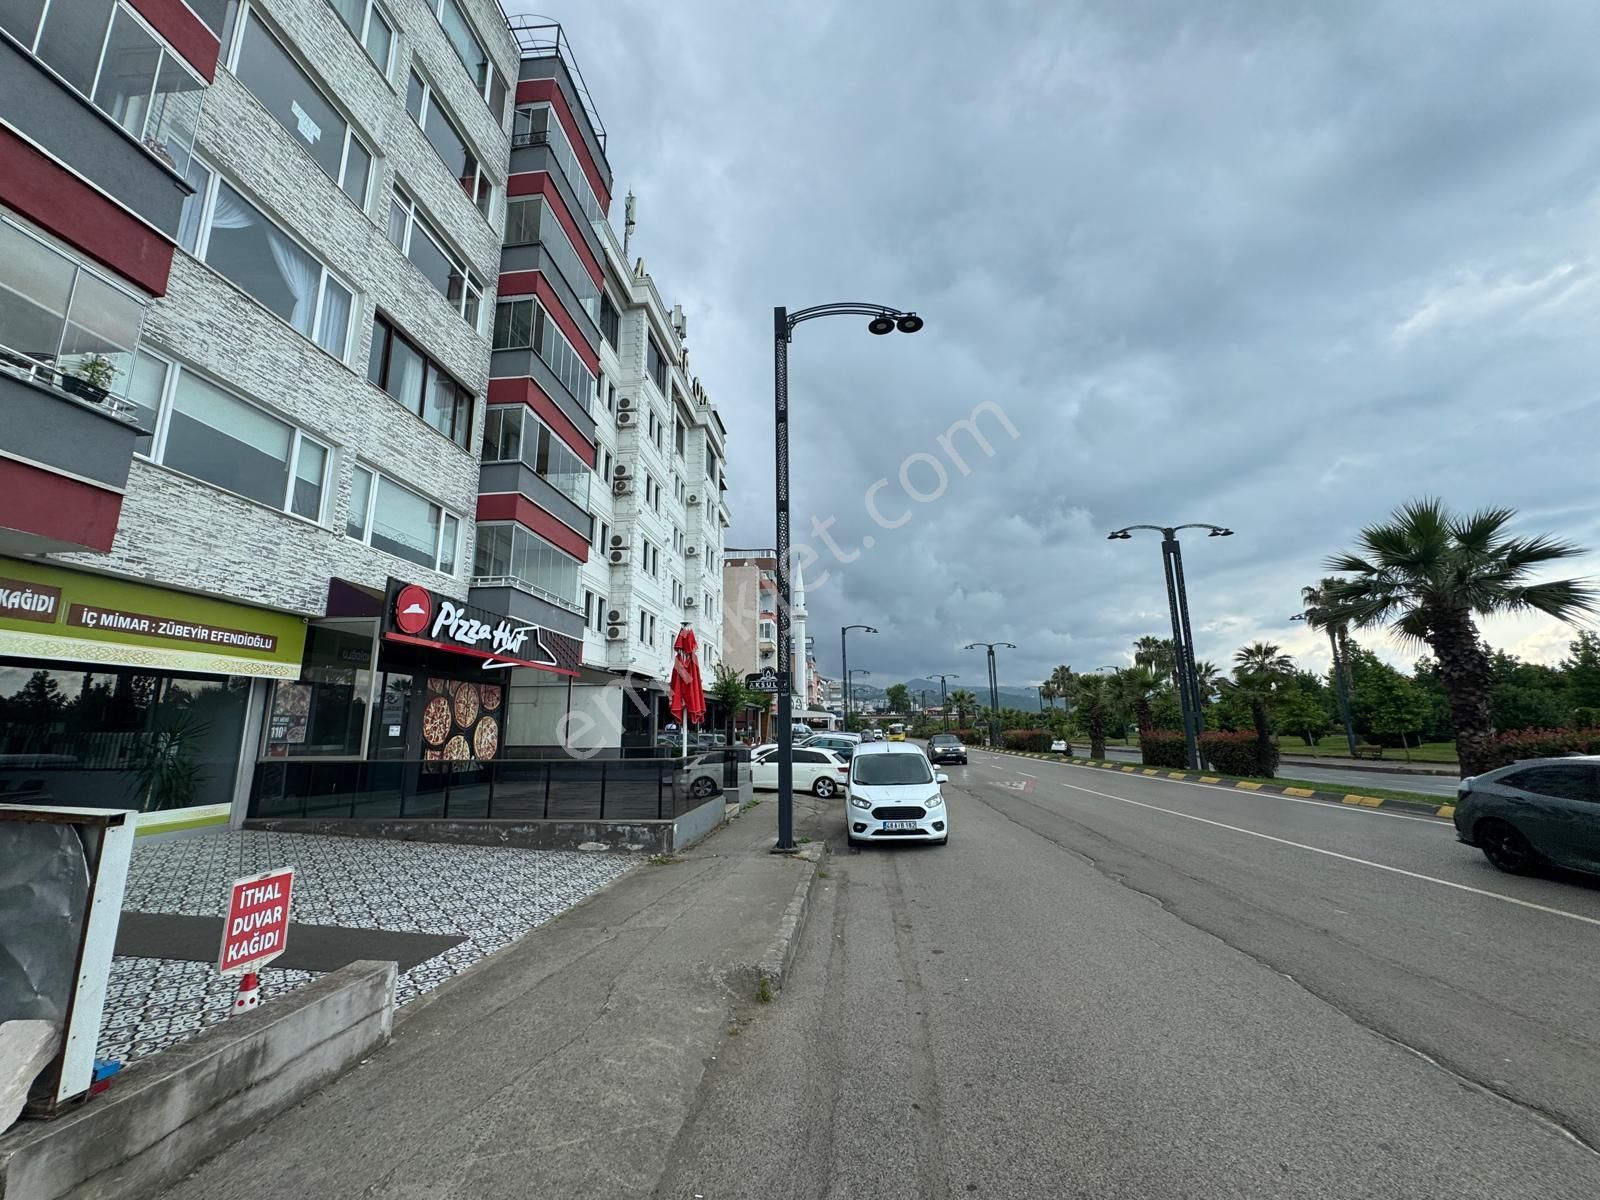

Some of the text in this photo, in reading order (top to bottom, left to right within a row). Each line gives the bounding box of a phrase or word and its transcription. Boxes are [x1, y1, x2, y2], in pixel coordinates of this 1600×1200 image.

[82, 608, 97, 628] İÇ
[100, 612, 149, 632] MİMAR
[158, 621, 208, 641] ZÜBEYİR
[210, 630, 272, 649] EFENDİOĞLU
[431, 601, 529, 655] Pizza Hut
[240, 882, 282, 909] İTHAL
[231, 906, 282, 936] DUVAR
[226, 929, 279, 962] KAĞIDI
